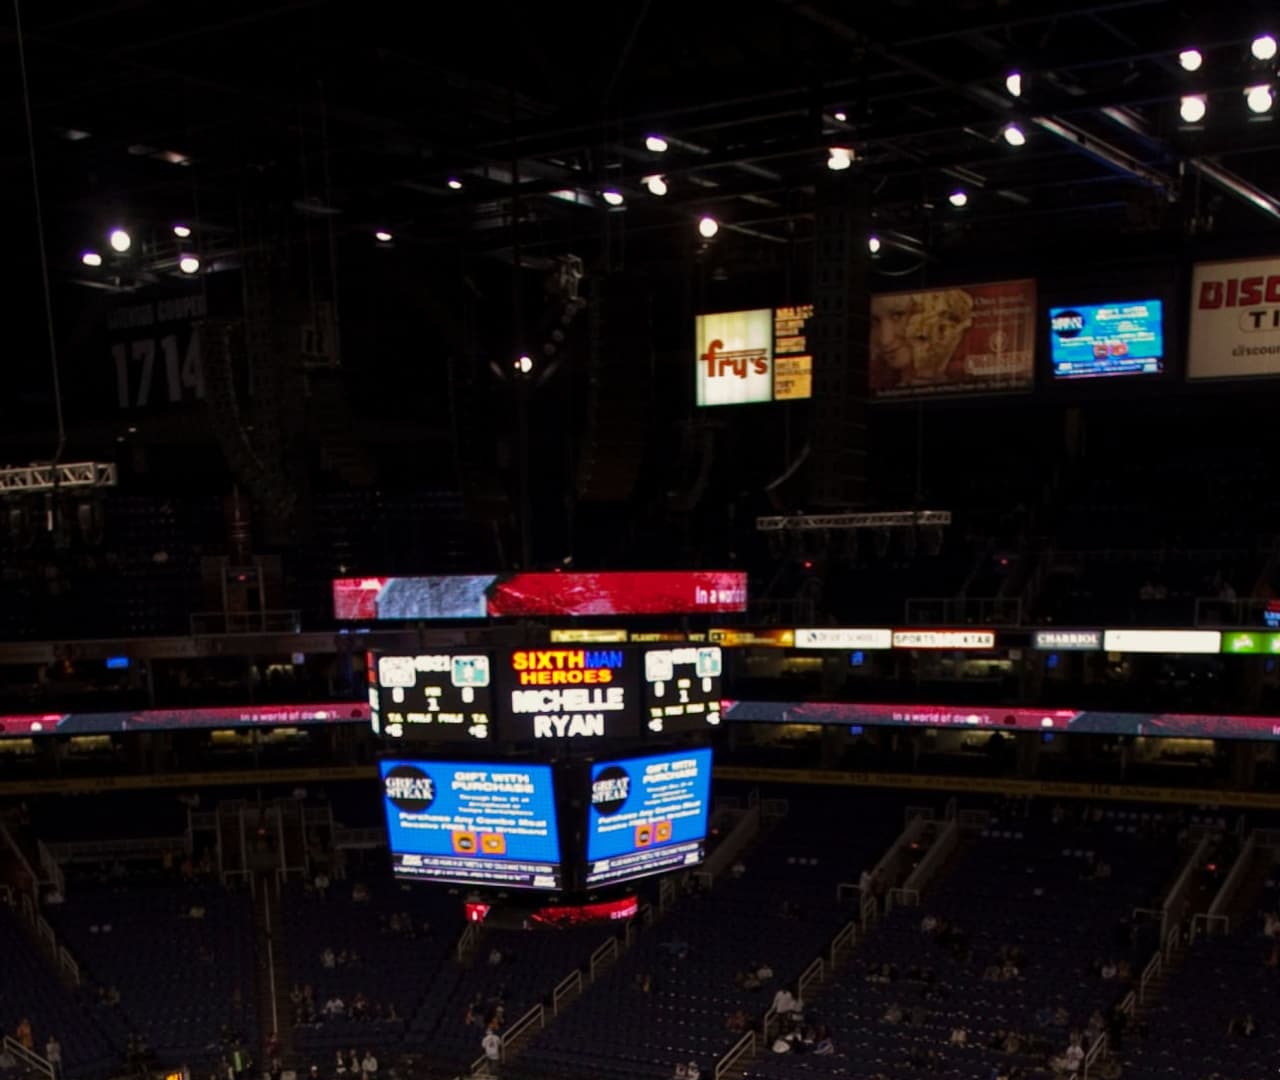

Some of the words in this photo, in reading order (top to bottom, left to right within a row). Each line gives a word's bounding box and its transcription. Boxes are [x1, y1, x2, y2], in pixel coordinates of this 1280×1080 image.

[700, 339, 767, 379] fry's
[519, 668, 613, 686] HEROES
[511, 687, 625, 714] MICHELLE
[533, 713, 605, 739] RYAN
[384, 776, 434, 790] GREAT
[453, 771, 488, 783] GIFT
[491, 772, 531, 785] WITH
[591, 776, 630, 793] GREAT
[385, 787, 434, 801] STEAK
[451, 780, 535, 794] PURCHASE
[591, 789, 628, 804] STEAK
